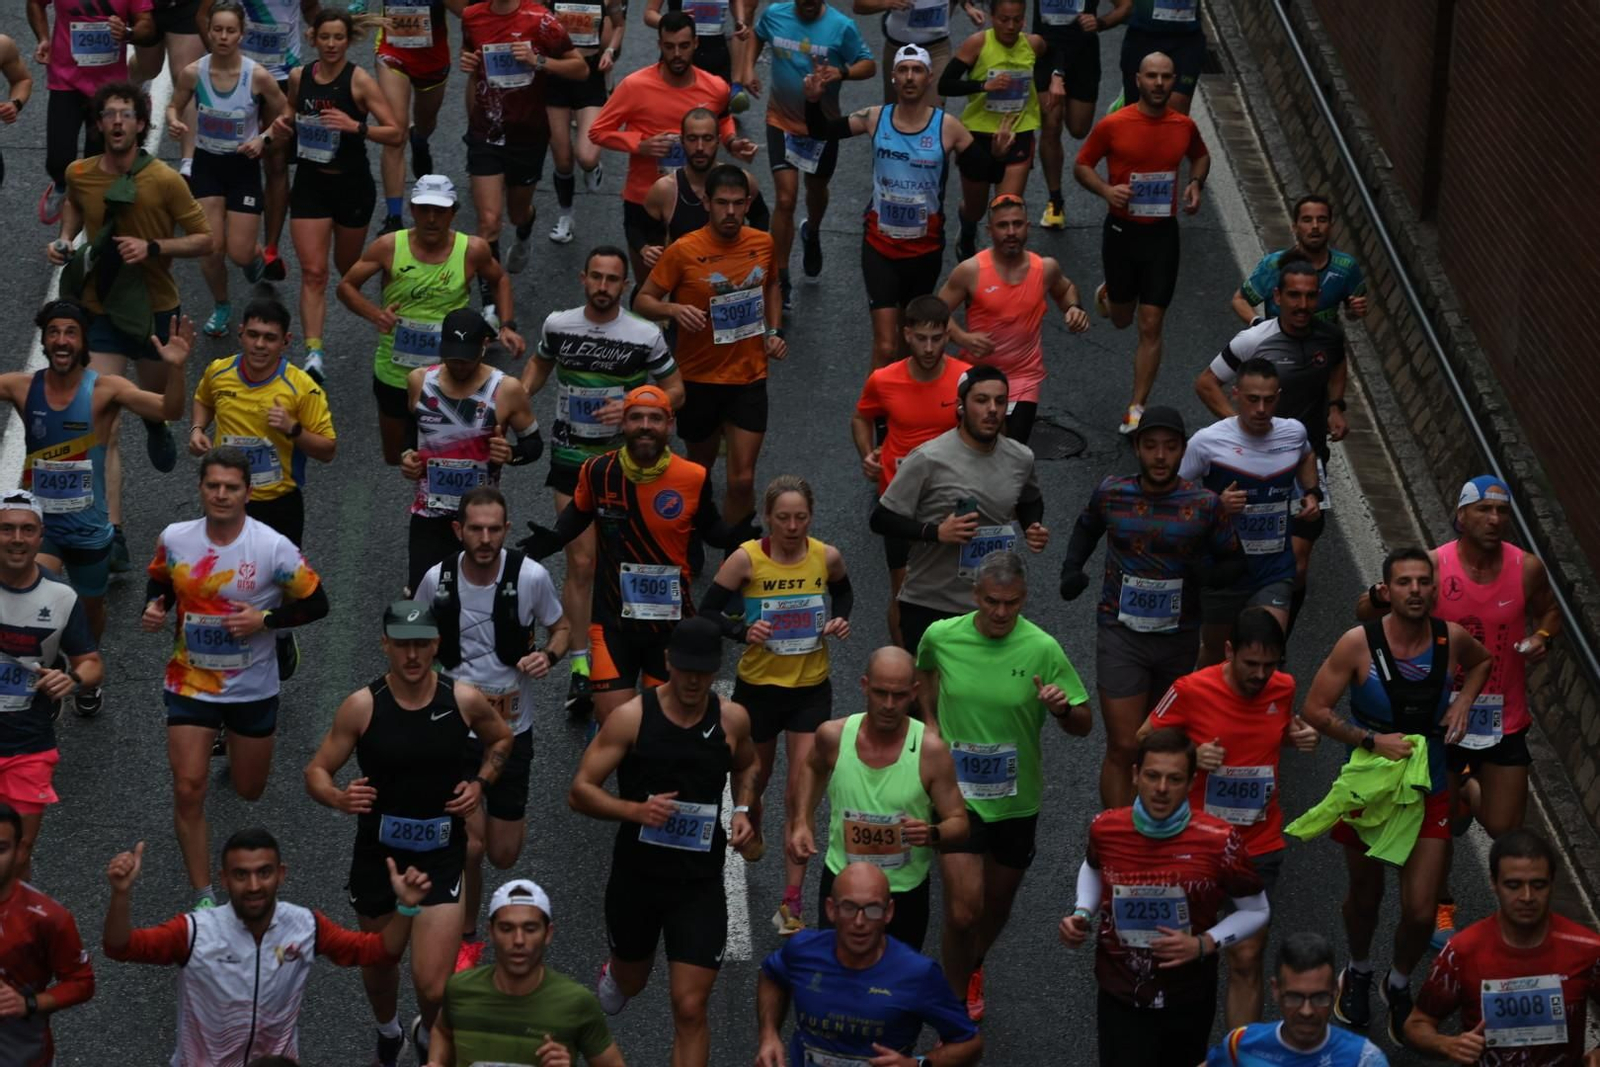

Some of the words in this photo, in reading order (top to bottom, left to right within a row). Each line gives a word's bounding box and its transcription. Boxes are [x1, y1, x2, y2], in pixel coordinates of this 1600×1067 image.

[78, 33, 109, 47] 2940
[1137, 184, 1168, 198] 2144
[886, 205, 916, 220] 1870
[719, 301, 753, 322] 3097
[400, 331, 435, 349] 3154
[43, 445, 71, 460] CLUB
[40, 473, 69, 490] 2492
[436, 470, 473, 487] 2402
[1238, 515, 1272, 532] 3228
[630, 577, 667, 596] 1509
[763, 579, 806, 591] WEST
[815, 578, 822, 588] 4
[1128, 590, 1168, 610] 2687
[194, 629, 235, 647] 1584
[2, 667, 22, 685] 48
[1470, 709, 1487, 726] 73
[961, 756, 1001, 775] 1927
[1214, 781, 1258, 799] 2468
[390, 821, 435, 842] 2826
[665, 816, 698, 837] 882
[853, 826, 895, 846] 3943
[1123, 901, 1170, 921] 2253
[1493, 995, 1542, 1018] 3008
